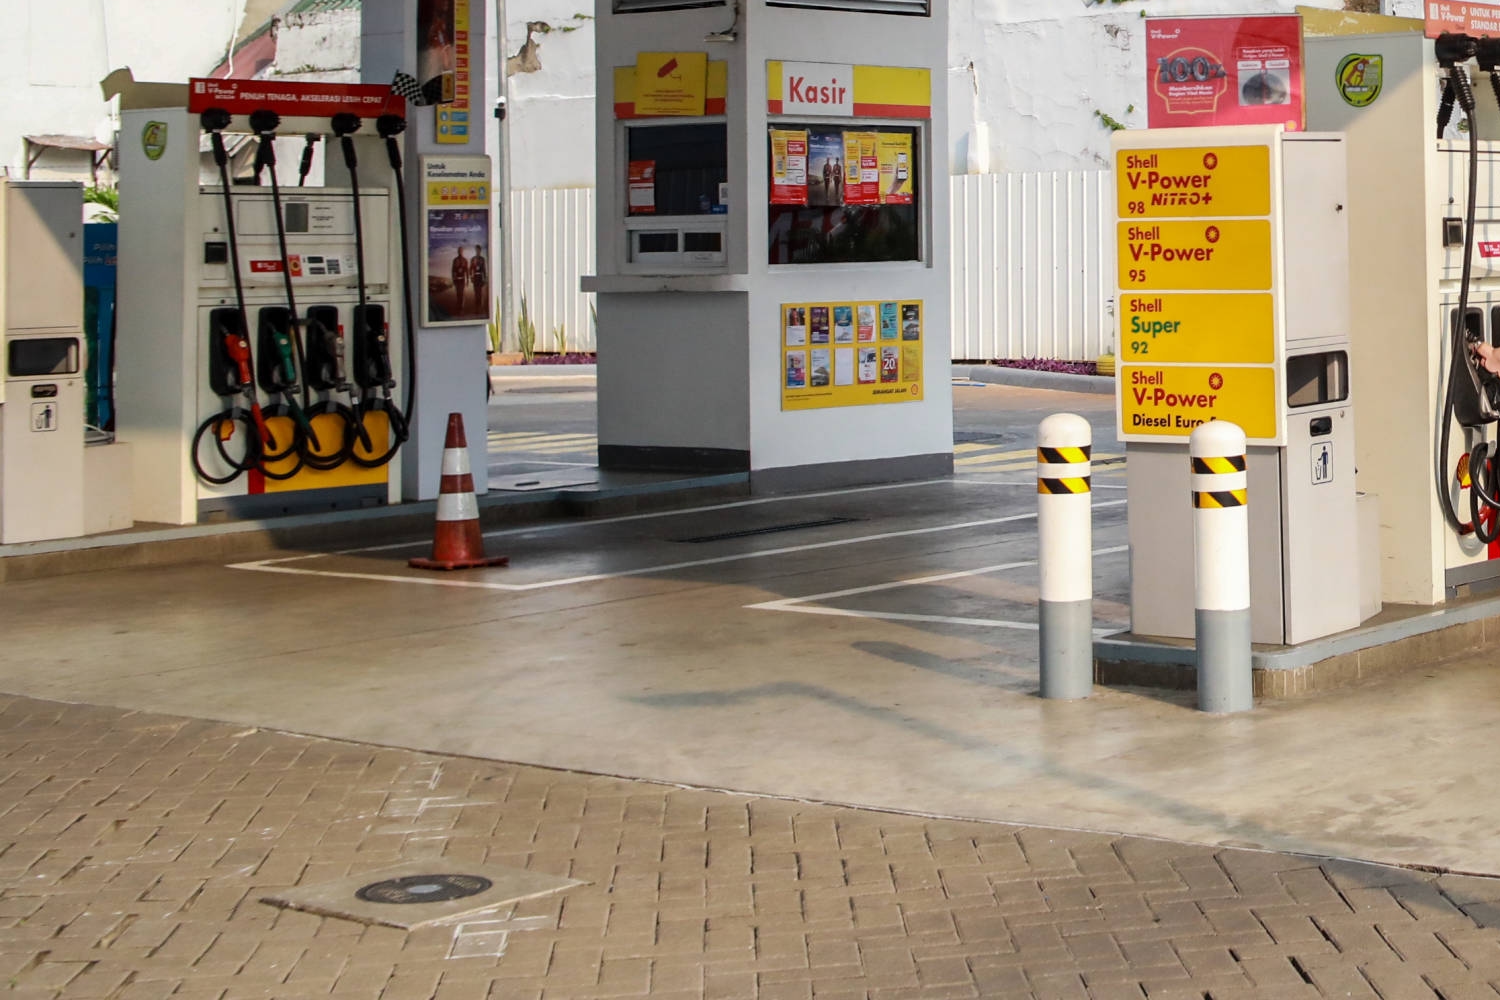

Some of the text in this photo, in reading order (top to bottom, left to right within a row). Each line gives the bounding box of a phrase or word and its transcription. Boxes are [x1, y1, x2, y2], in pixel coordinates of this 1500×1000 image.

[1441, 11, 1465, 23] V-Power
[1470, 7, 1491, 17] UNTUK
[1471, 20, 1498, 32] STANDAR
[789, 76, 846, 104] Kasir
[240, 93, 265, 101] PENUH
[267, 93, 299, 102] TENAGA,
[300, 94, 340, 103] AKSELERASI
[1127, 154, 1158, 169] Shell
[427, 170, 468, 178] Keselamatan
[1127, 171, 1211, 190] V-Power
[1128, 201, 1145, 214] 98
[1128, 226, 1160, 240] Shell
[1129, 243, 1214, 262] V-Power
[1129, 269, 1146, 282] 95
[1130, 299, 1162, 313] Shell
[1131, 316, 1181, 338] Super
[1131, 341, 1148, 354] 92
[1132, 371, 1163, 385] Shell
[1132, 387, 1217, 408] V-Power
[1132, 413, 1205, 428] Diesel Euro
